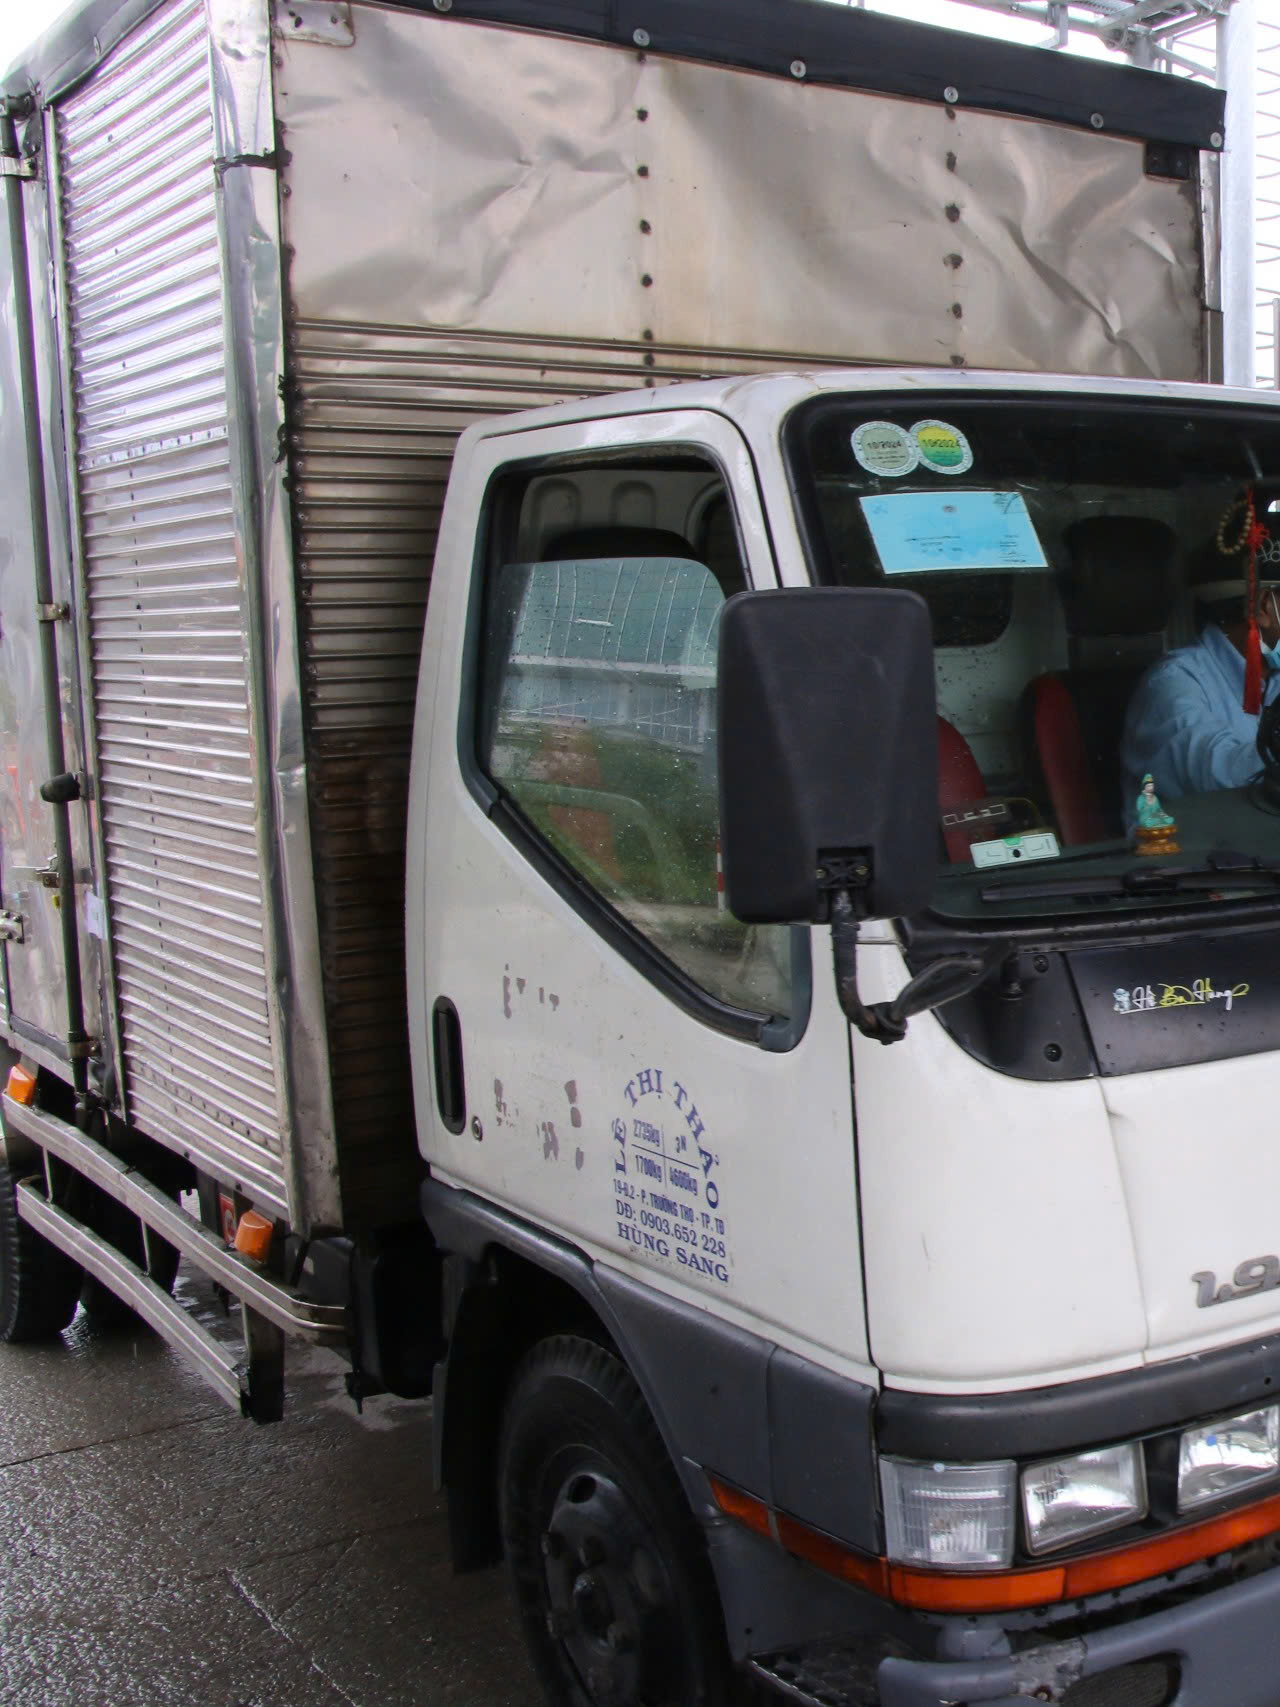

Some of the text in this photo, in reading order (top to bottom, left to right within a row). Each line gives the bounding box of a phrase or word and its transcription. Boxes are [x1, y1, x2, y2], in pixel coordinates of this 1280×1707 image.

[624, 1068, 664, 1107] THỊ
[673, 1081, 720, 1209] THẢO
[617, 1221, 729, 1283] HÙNG SANG
[640, 1209, 698, 1246] 0903.652
[701, 1234, 727, 1258] 228
